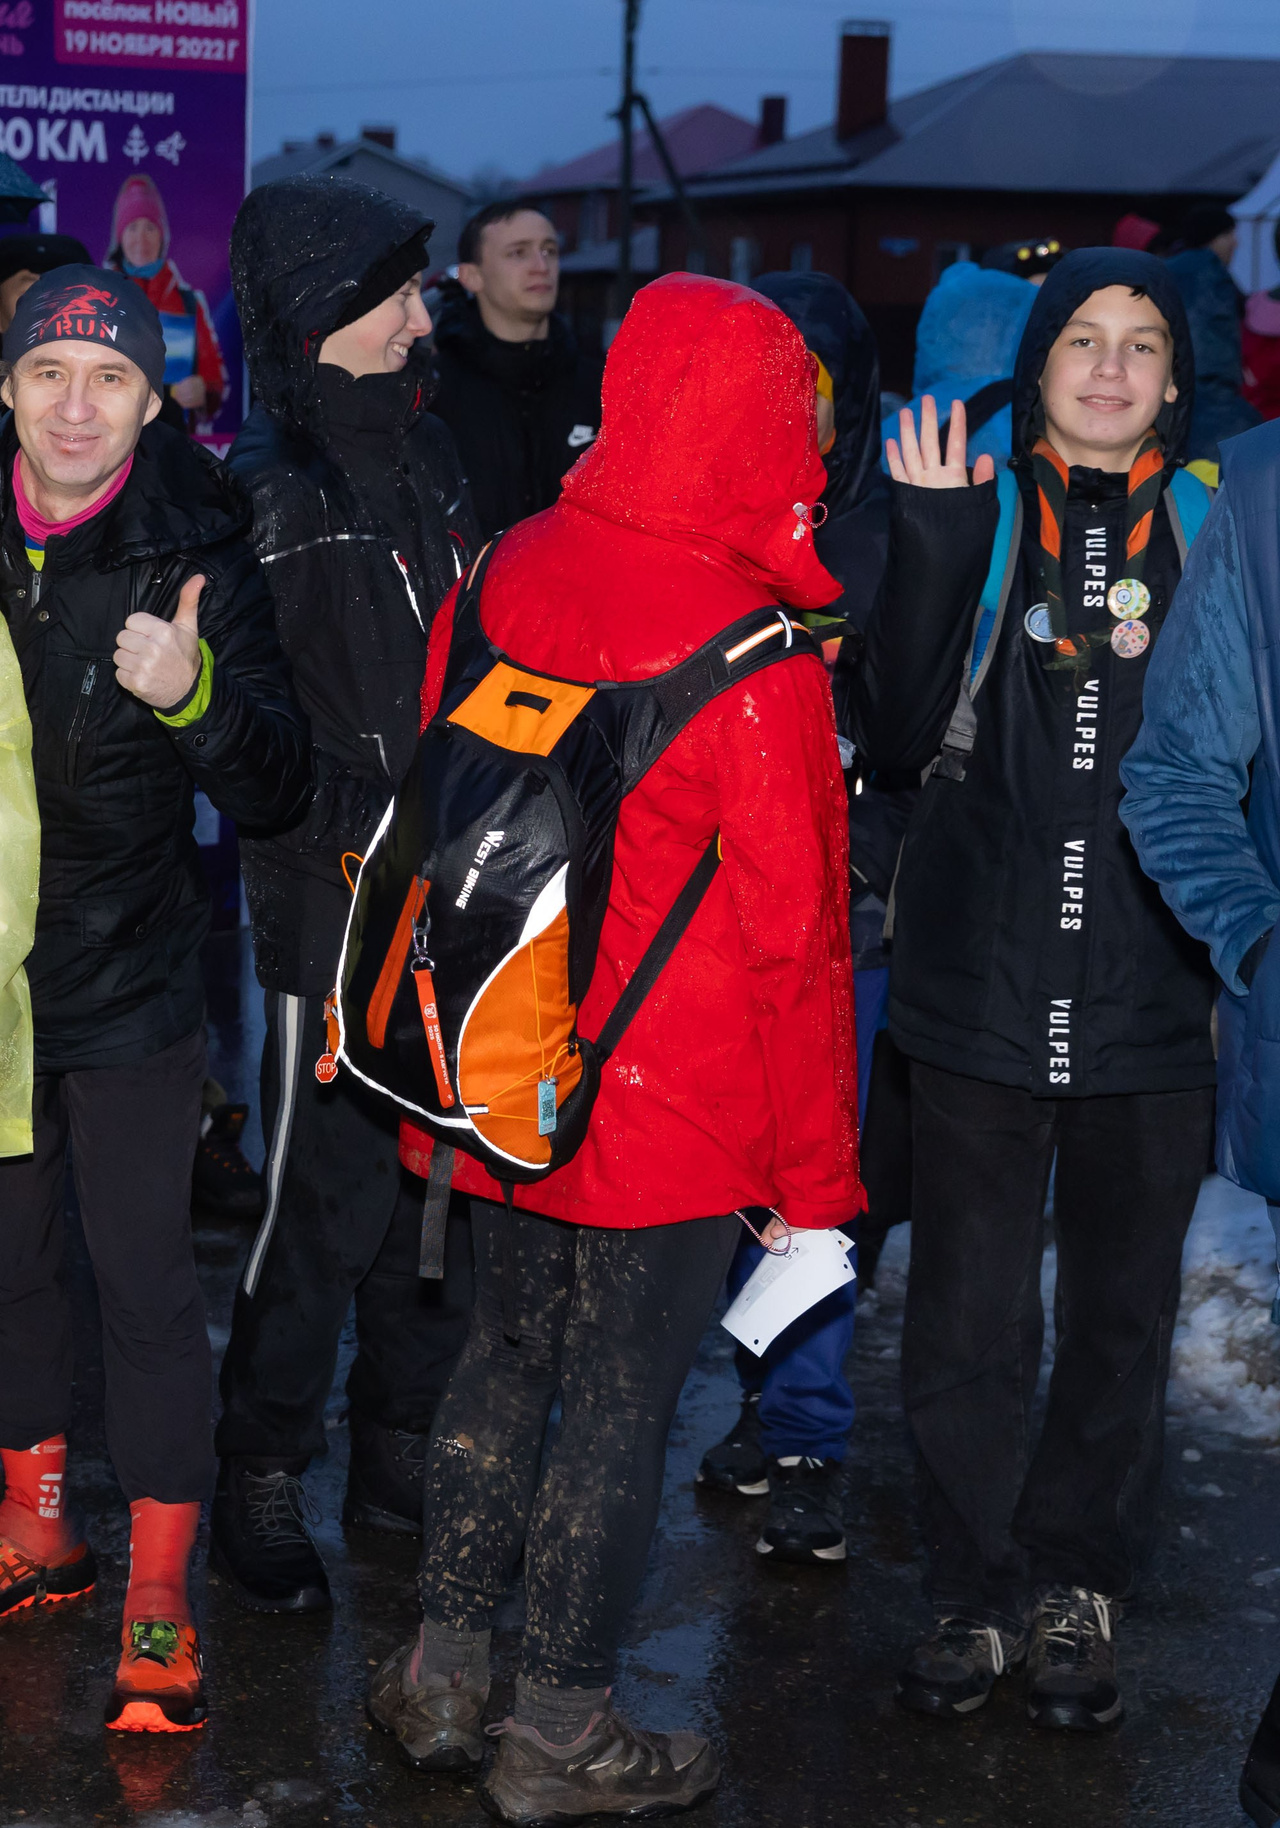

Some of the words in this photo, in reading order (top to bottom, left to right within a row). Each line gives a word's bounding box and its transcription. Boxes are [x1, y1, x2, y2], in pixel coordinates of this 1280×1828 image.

[155, 0, 239, 28] НОВЫЙ
[64, 30, 88, 53] 19
[90, 31, 174, 58] НОЯБРЯ
[176, 36, 225, 61] 2022
[48, 86, 175, 117] ДИСТАНЦИИ
[37, 117, 108, 163] КМ
[56, 319, 119, 342] RUN
[1083, 527, 1107, 607] VULPES
[1072, 679, 1099, 770] VULPES
[473, 830, 505, 866] WEST
[455, 867, 480, 910] BIKING
[1060, 840, 1085, 930] VULPES
[1048, 999, 1072, 1084] VULPES
[317, 1062, 336, 1075] STOP
